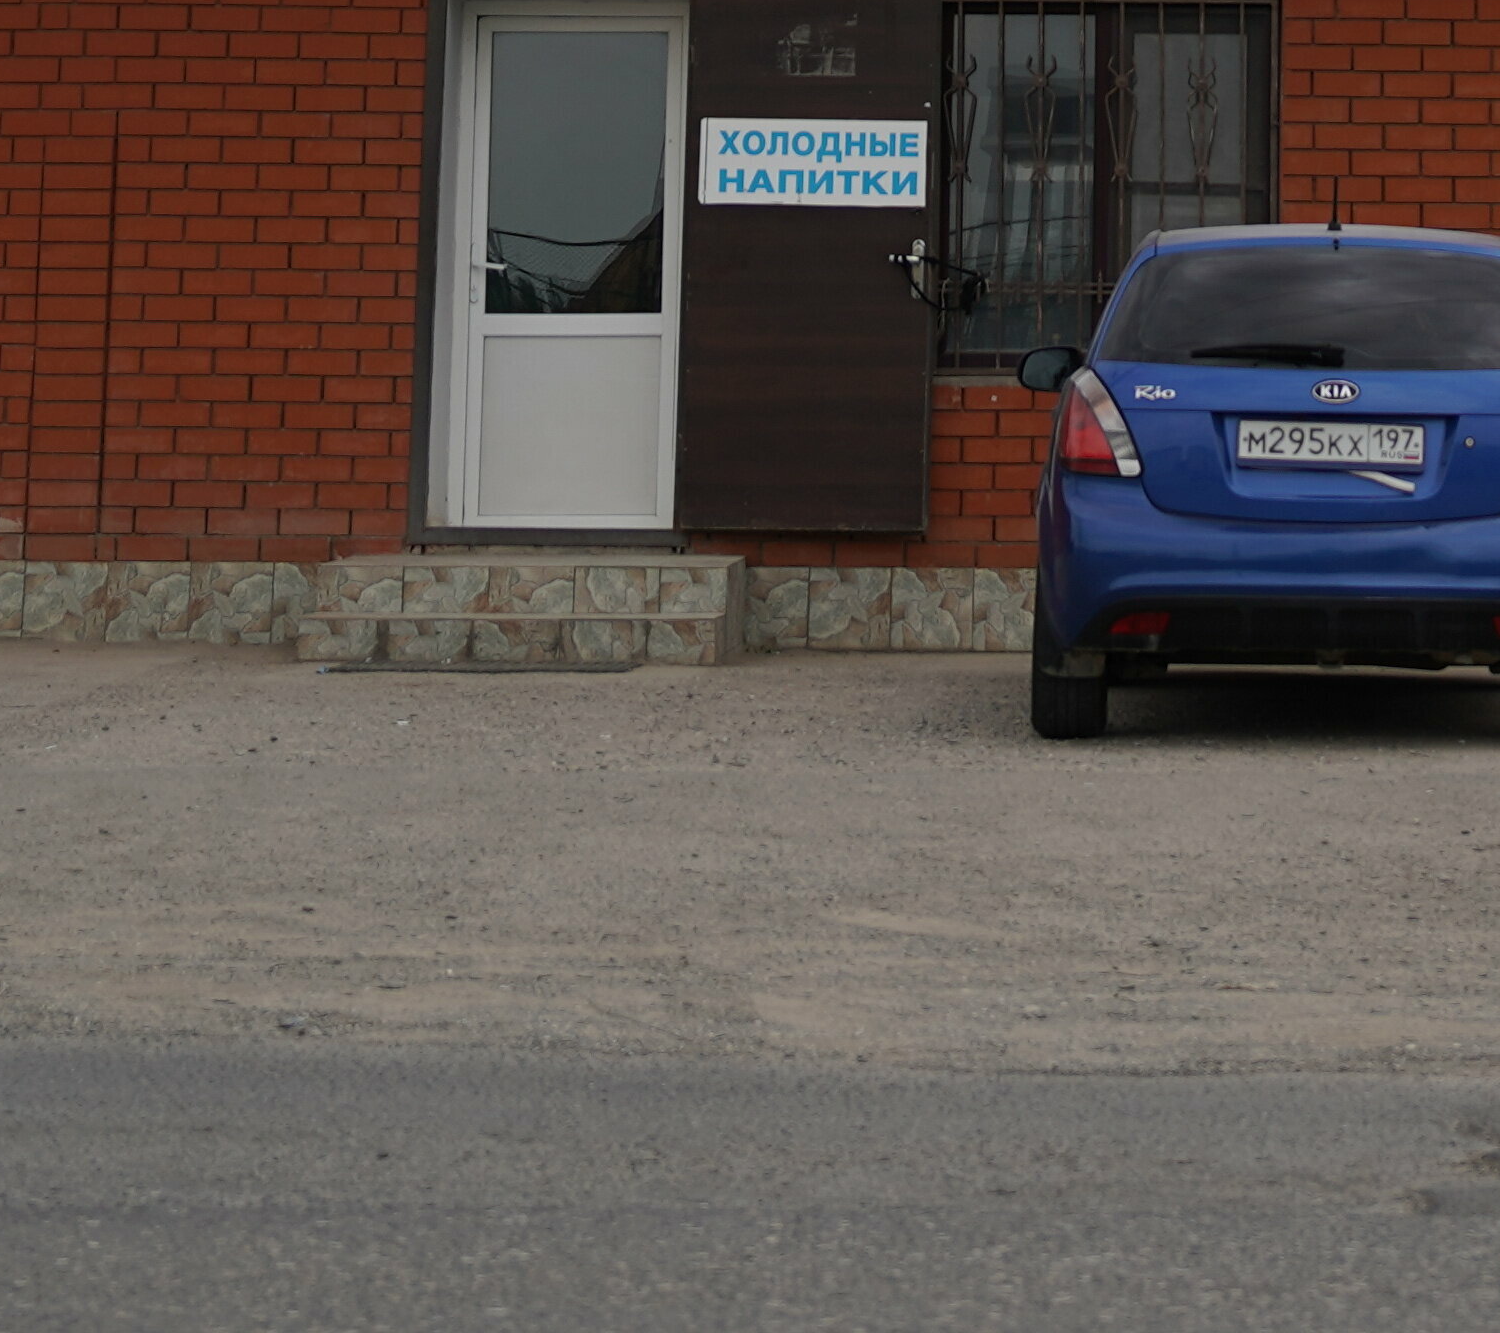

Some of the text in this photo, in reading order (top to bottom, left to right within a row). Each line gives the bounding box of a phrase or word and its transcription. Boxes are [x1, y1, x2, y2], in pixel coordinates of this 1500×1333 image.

[718, 129, 920, 163] ХОЛОДНЫЕ
[718, 168, 919, 196] НАПИТКИ
[1134, 384, 1176, 401] Rio
[1319, 384, 1352, 398] KIA
[1247, 426, 1415, 456] М295КХ 197
